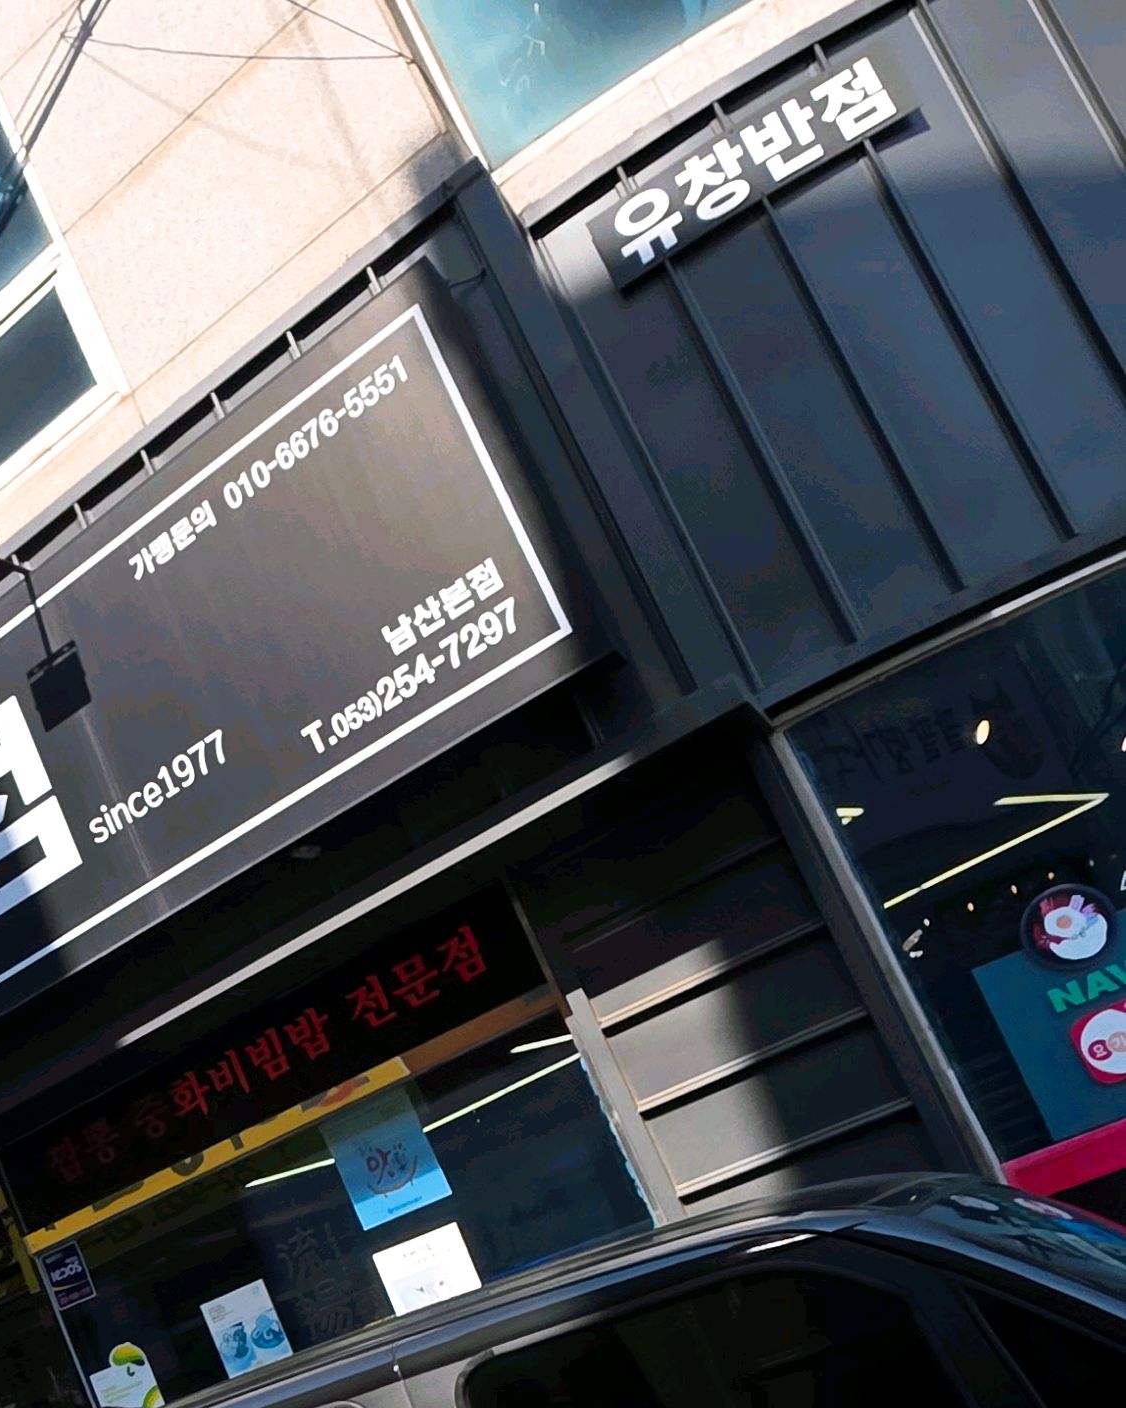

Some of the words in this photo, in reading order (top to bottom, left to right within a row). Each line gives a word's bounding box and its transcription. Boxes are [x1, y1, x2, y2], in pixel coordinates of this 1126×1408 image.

[613, 56, 898, 265] 유창반점
[128, 506, 218, 581] 가맹문의
[222, 354, 410, 511] 010-6676-5551
[299, 596, 517, 755] T.053)254-7297
[380, 556, 505, 657] 남산본점
[87, 728, 229, 845] since1977
[344, 924, 489, 1029] 전문점
